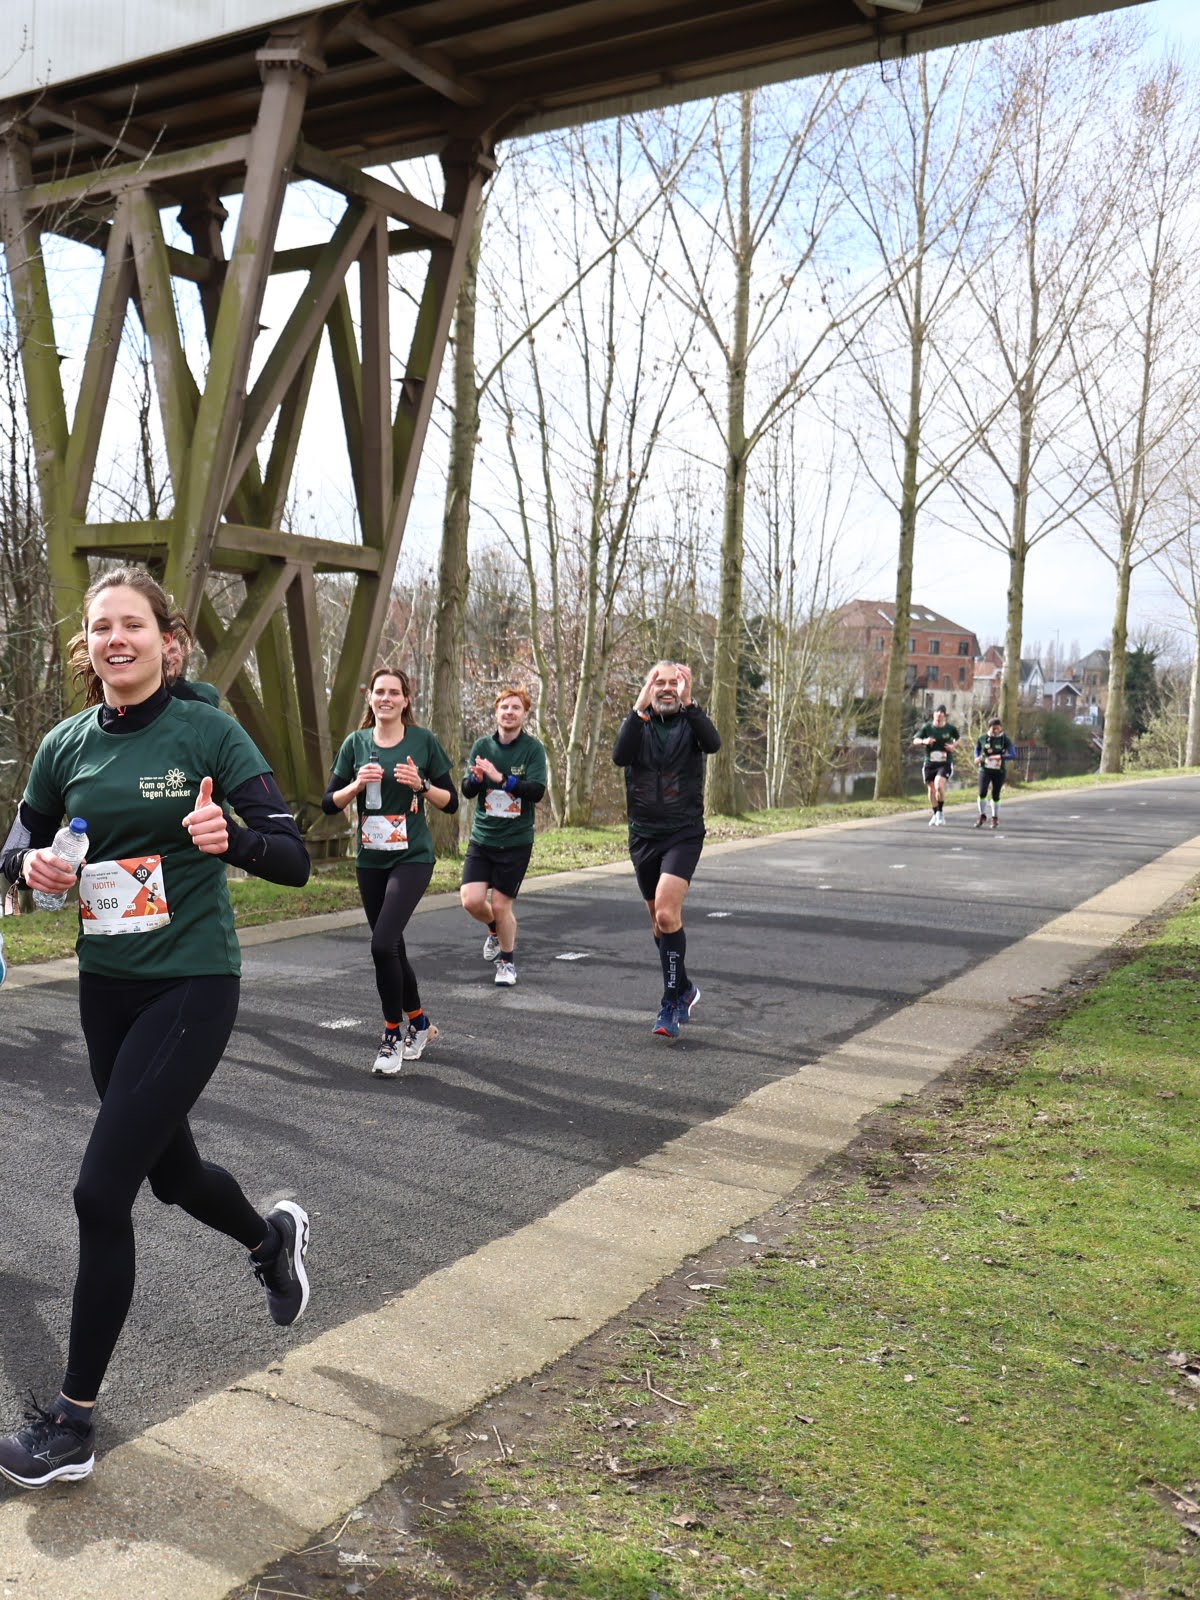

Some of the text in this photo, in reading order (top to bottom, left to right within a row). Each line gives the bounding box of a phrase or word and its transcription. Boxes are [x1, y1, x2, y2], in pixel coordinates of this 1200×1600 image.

[139, 780, 166, 791] Kom op
[142, 788, 191, 800] tegen Kanker
[136, 868, 148, 878] 30
[92, 881, 116, 890] JUDITH
[96, 897, 119, 910] 368
[666, 950, 680, 989] Kalenji
